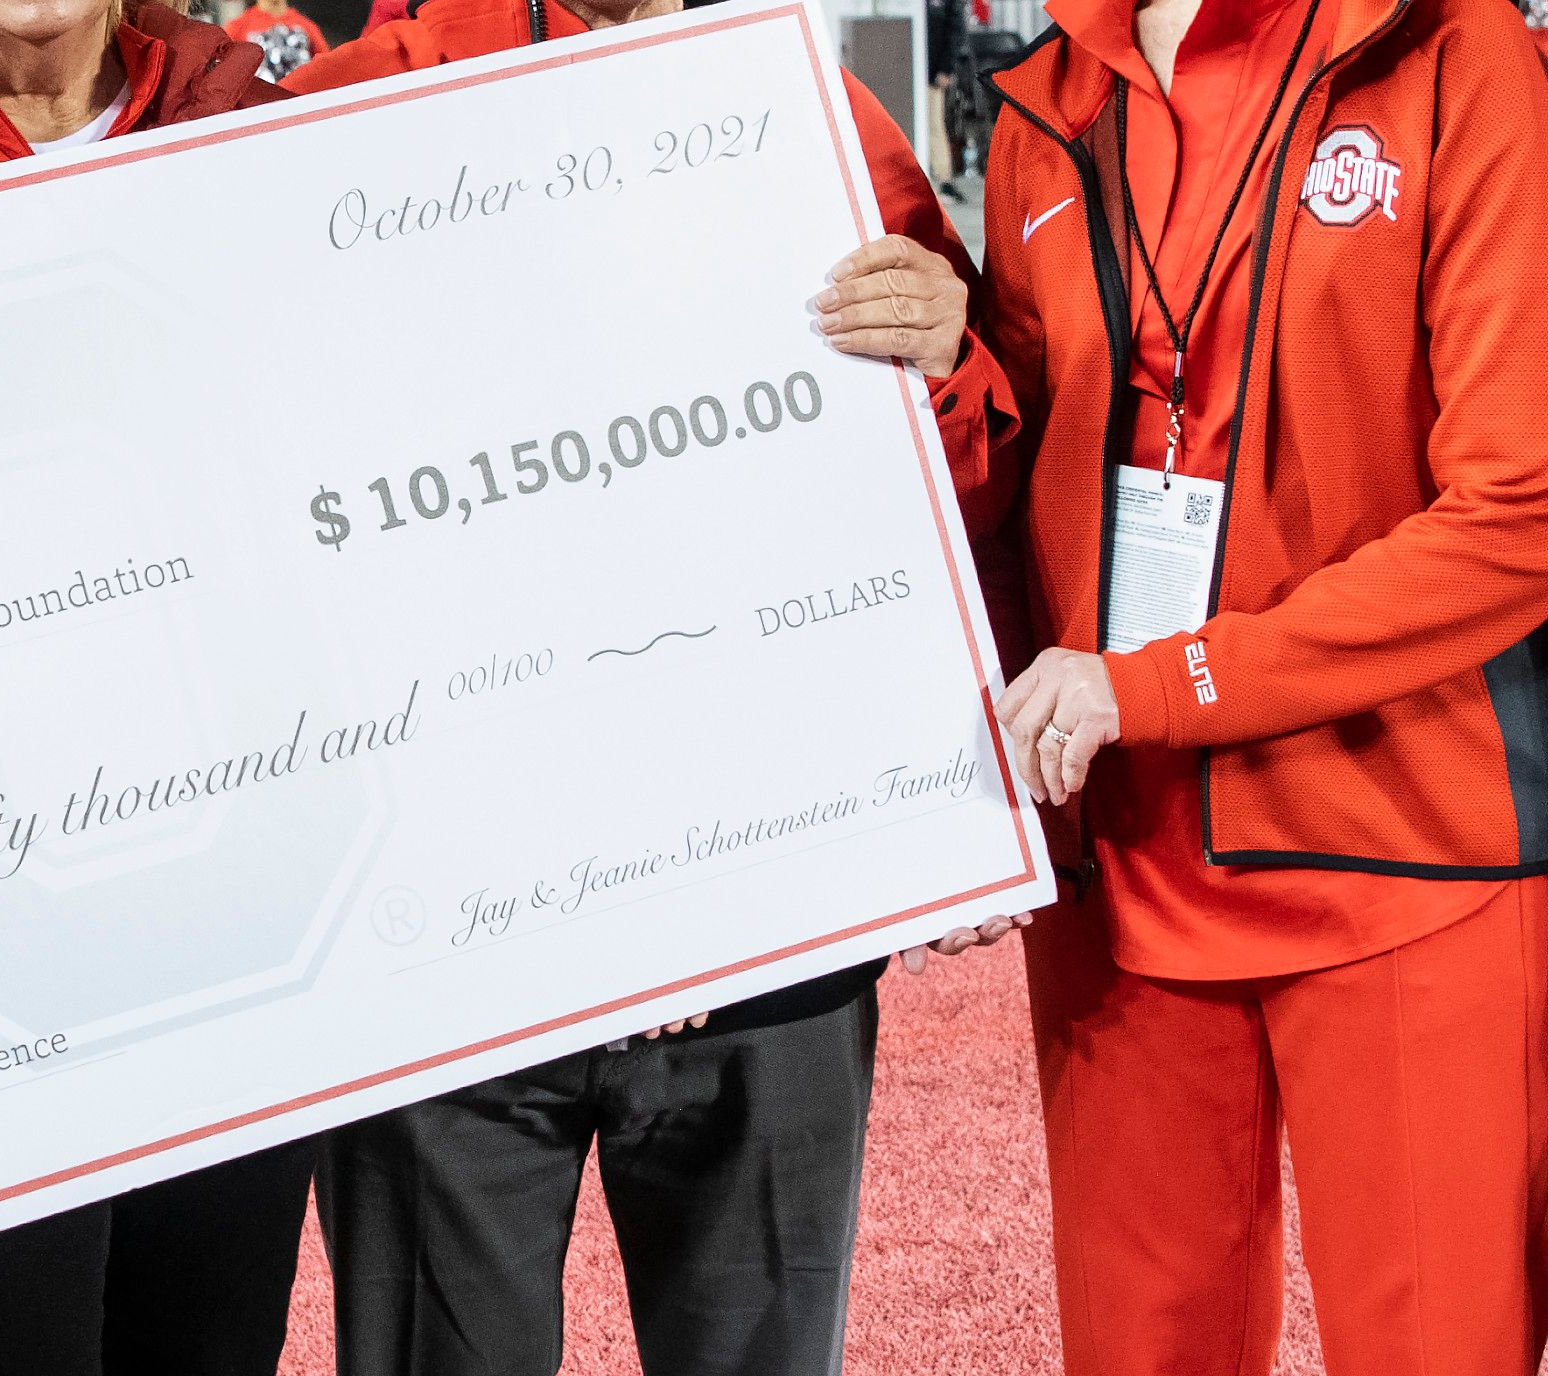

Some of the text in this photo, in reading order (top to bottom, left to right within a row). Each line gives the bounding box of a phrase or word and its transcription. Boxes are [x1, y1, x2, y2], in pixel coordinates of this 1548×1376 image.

[327, 107, 775, 252] October 30, 2021
[1300, 150, 1401, 222] HIO STATE
[309, 369, 824, 554] $ 10,150,000.00
[753, 568, 912, 638] DOLLARS
[60, 712, 309, 836] thousand
[319, 678, 421, 765] and
[450, 747, 983, 948] Jay & Jeanie Schottenstein Family
